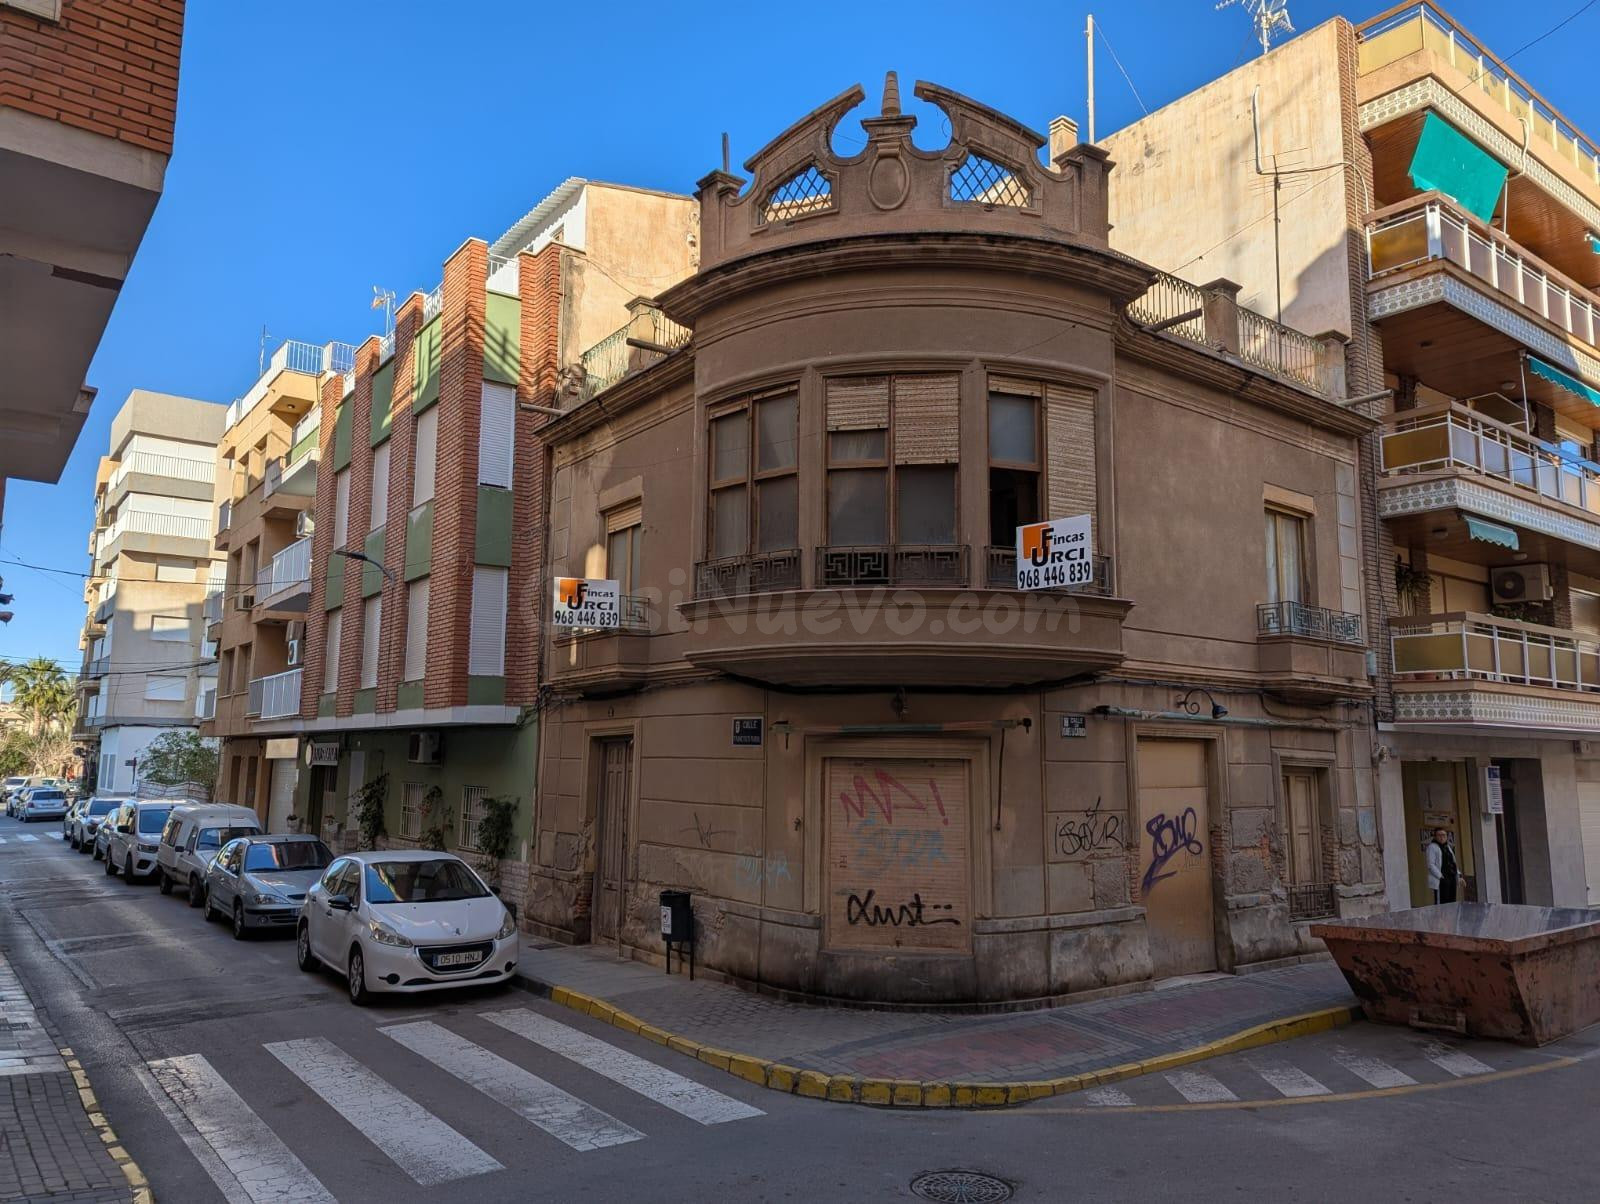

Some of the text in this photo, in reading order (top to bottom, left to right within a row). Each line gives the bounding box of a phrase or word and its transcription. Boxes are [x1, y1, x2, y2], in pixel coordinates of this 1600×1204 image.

[1041, 527, 1085, 547] Fincas
[1031, 547, 1085, 567] URCI
[1019, 560, 1091, 589] 968 446 839
[576, 583, 615, 598] Fincas
[567, 595, 614, 610] URCI
[554, 610, 618, 626] 968 446 839
[440, 951, 480, 964] 0510 HNJ
